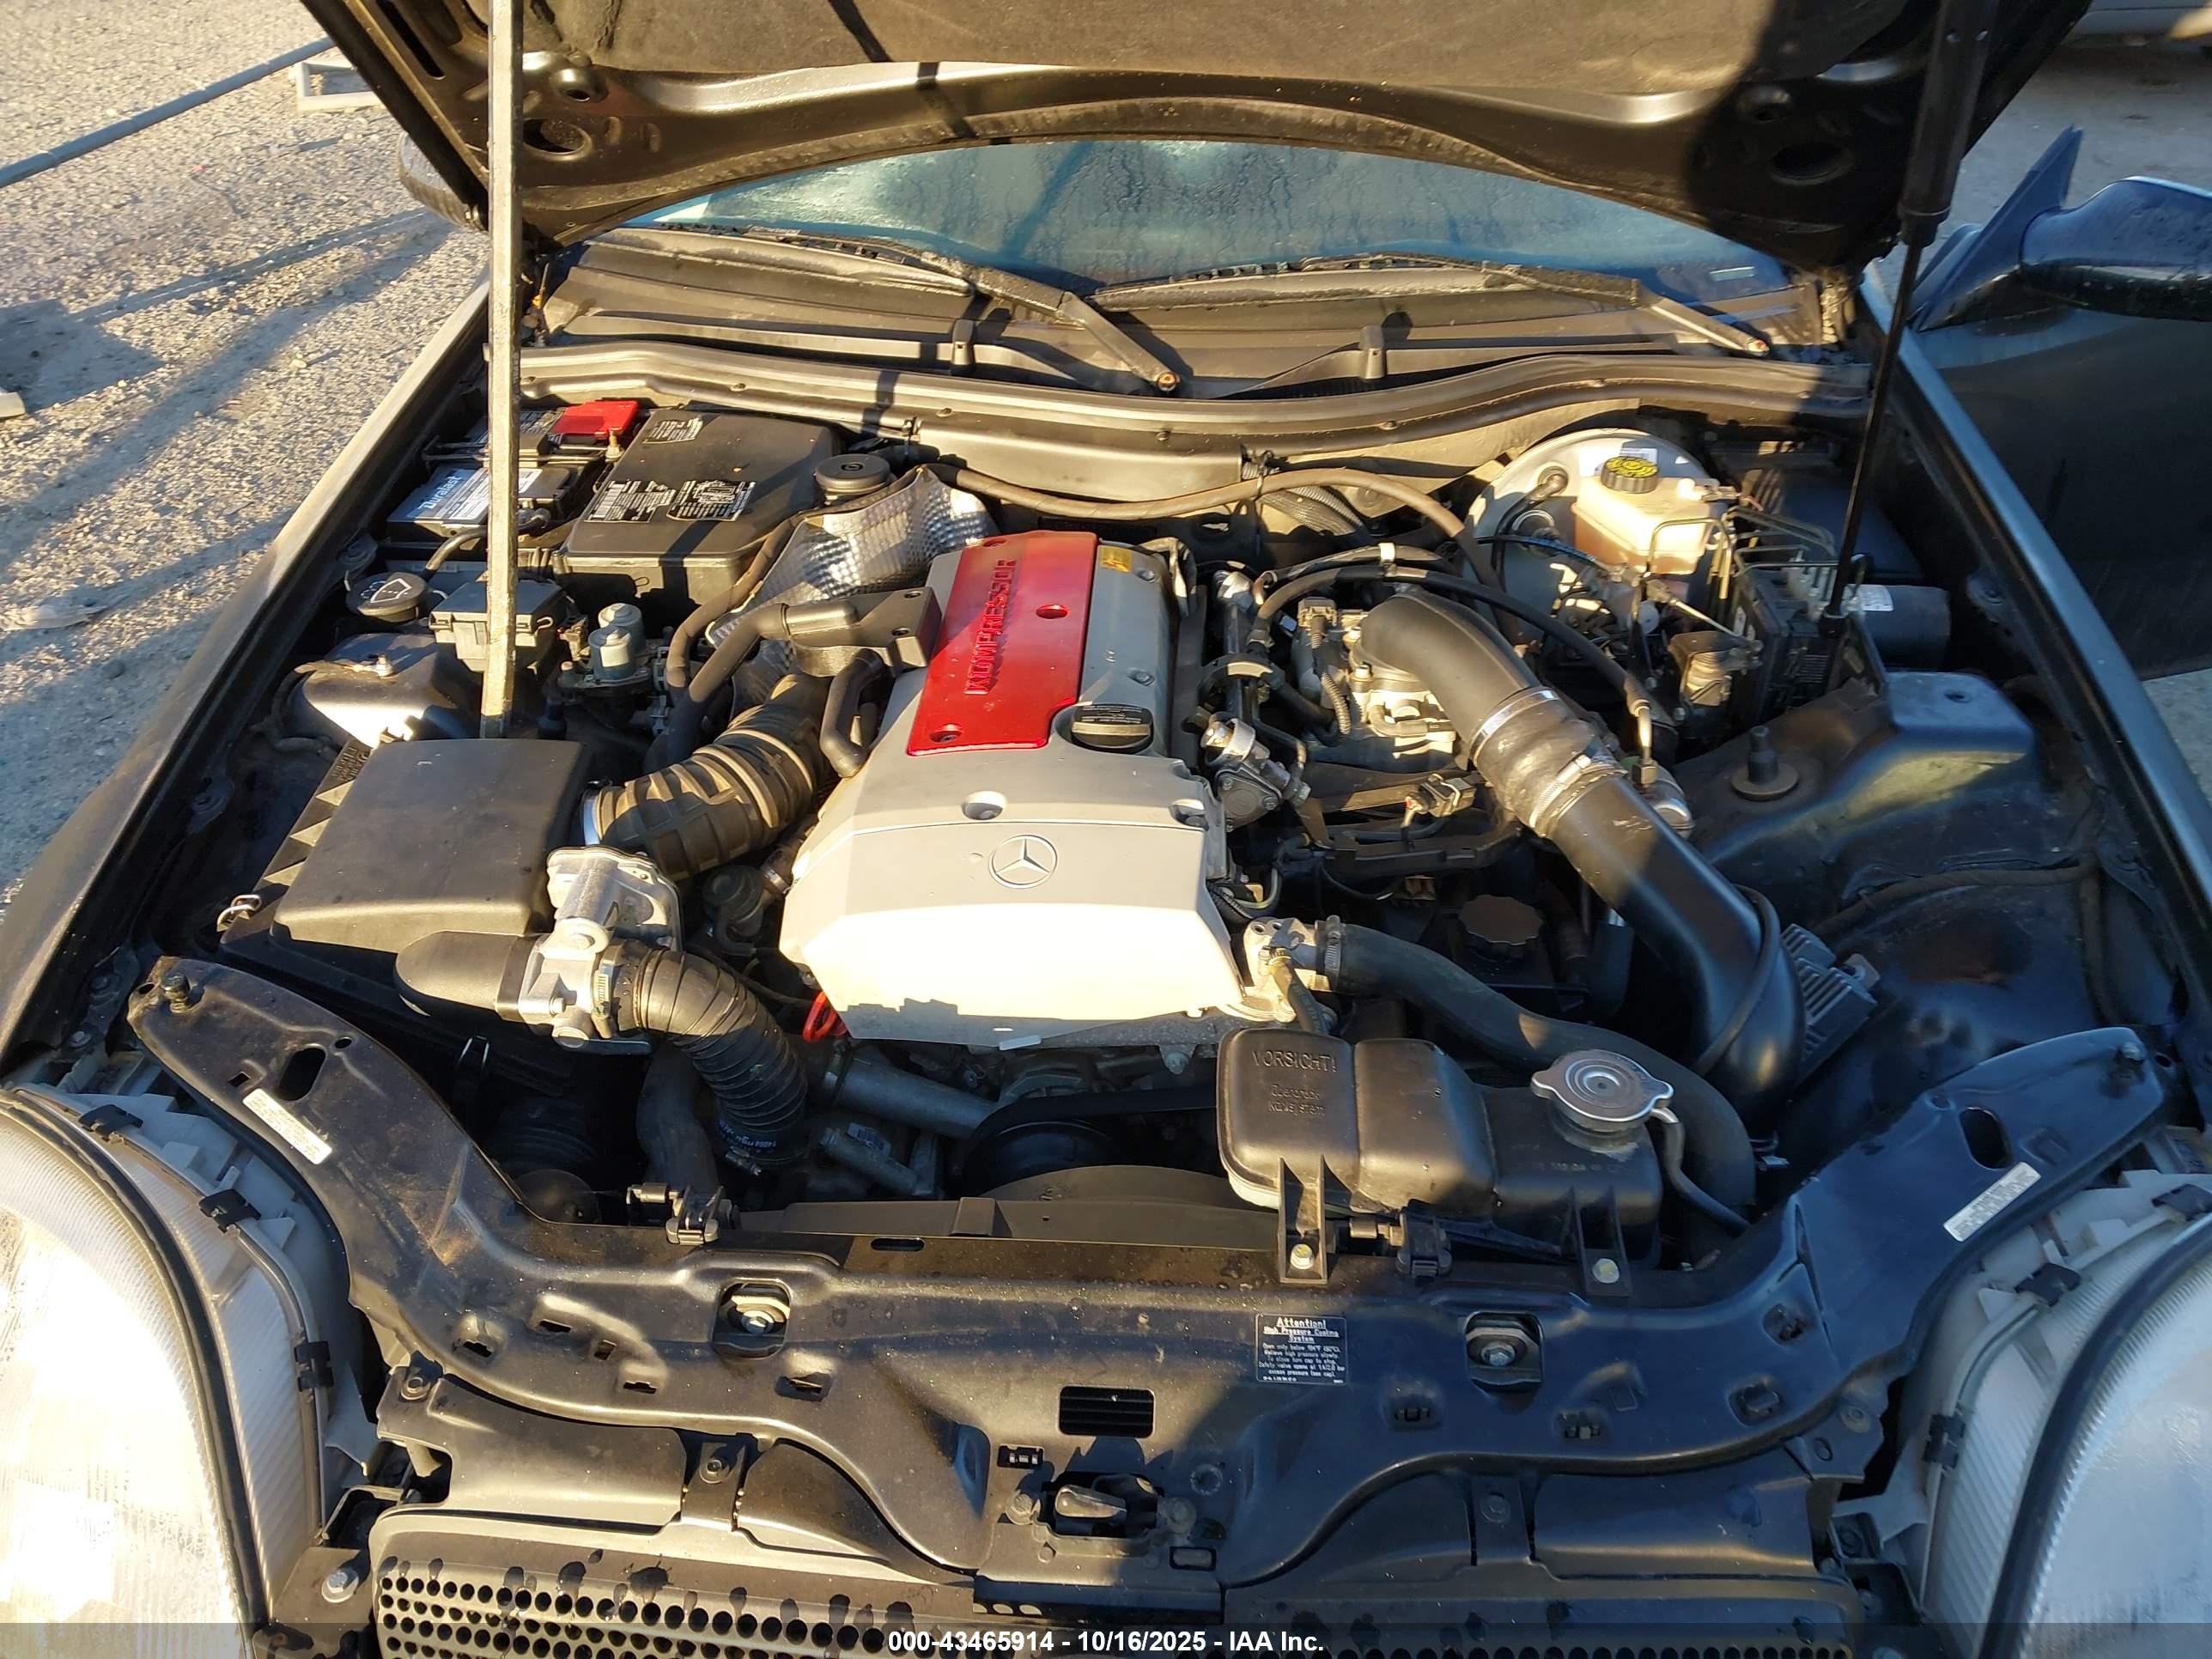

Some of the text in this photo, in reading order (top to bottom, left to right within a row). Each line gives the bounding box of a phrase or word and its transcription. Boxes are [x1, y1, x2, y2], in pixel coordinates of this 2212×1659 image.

[417, 476, 462, 509] Duralast
[963, 559, 1018, 695] KOMPRESSOR
[1251, 1049, 1337, 1073] VORSICHT!
[1276, 1316, 1326, 1328] Attention!
[1280, 1328, 1311, 1336] Pressure
